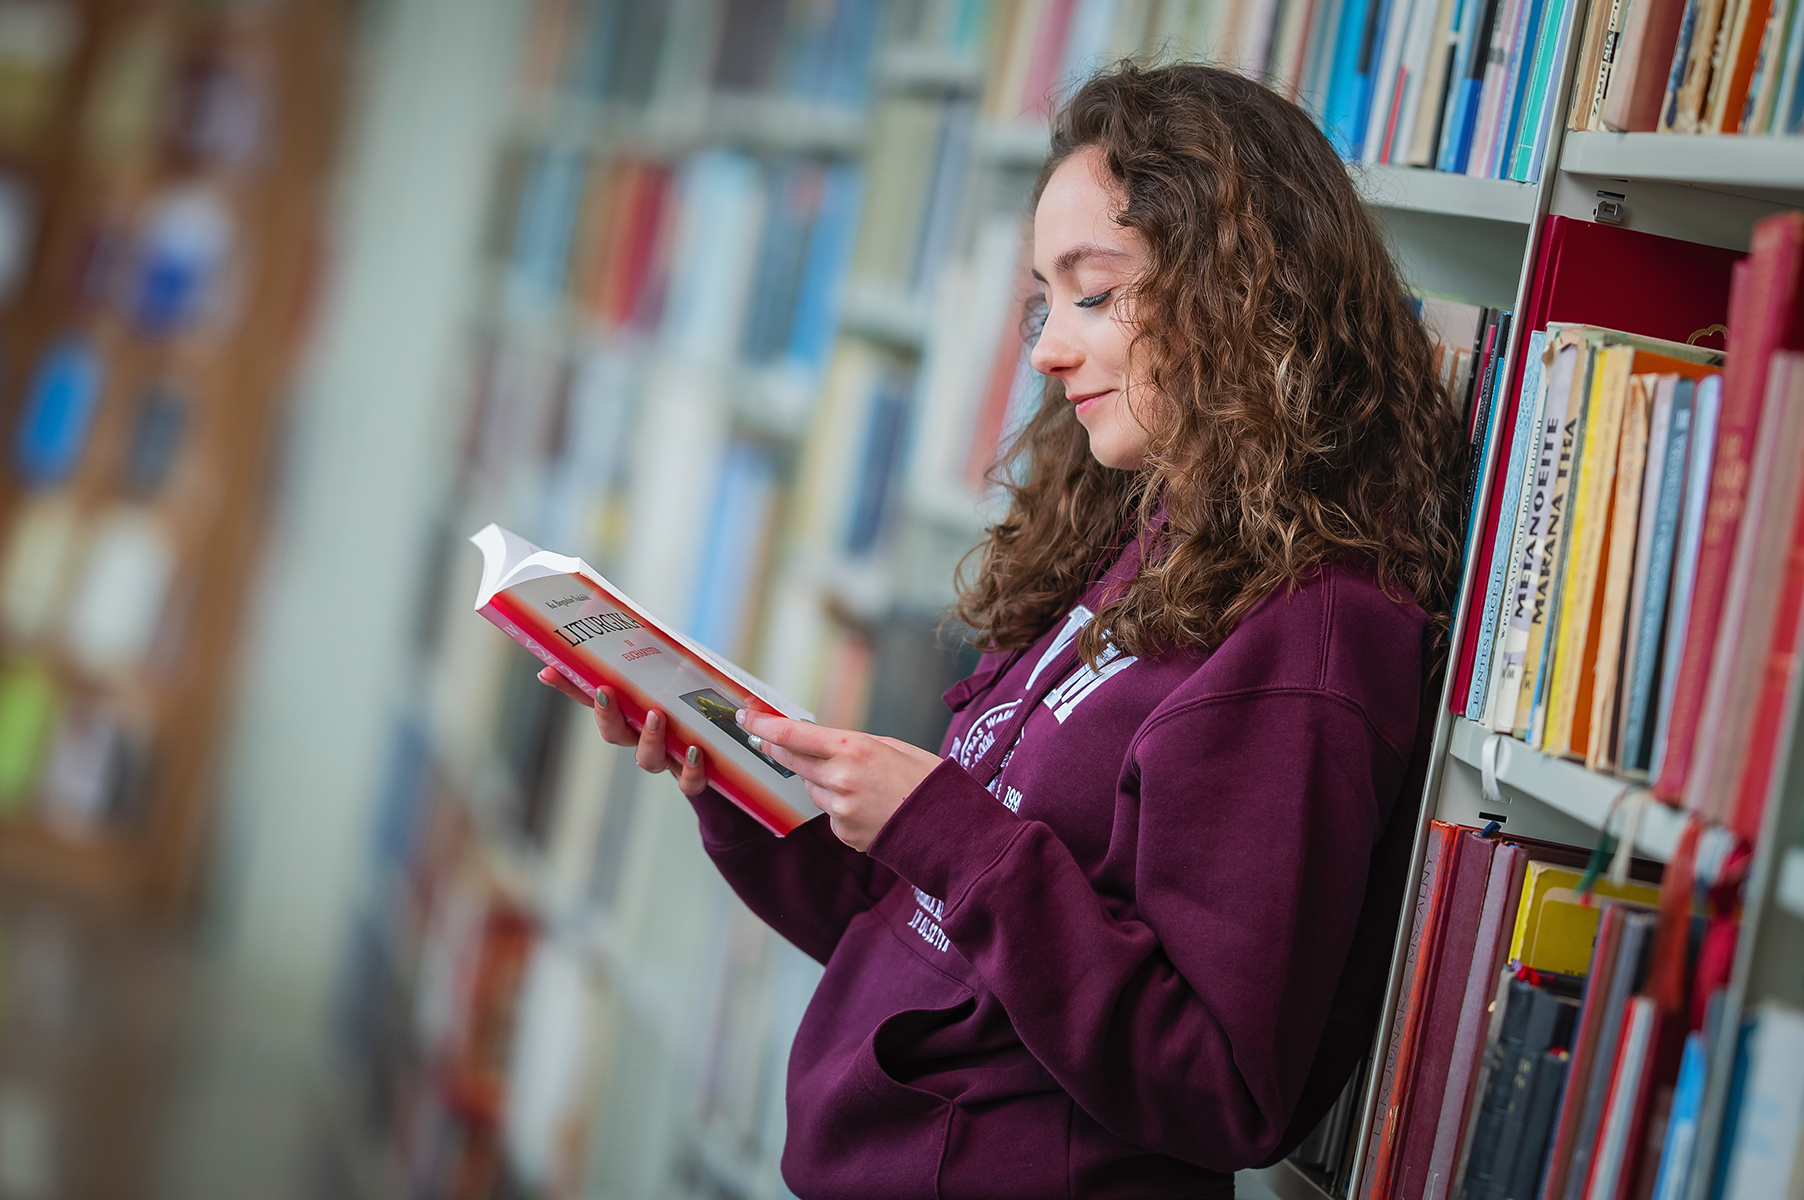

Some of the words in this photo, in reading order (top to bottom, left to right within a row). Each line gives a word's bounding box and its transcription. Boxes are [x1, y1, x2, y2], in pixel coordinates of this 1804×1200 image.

[1501, 521, 1526, 639] WPROWADZENIE
[1522, 494, 1530, 514] DO
[1532, 493, 1564, 624] MARANA
[553, 611, 647, 648] LITURGIKA
[1473, 638, 1490, 706] EUNTES
[1486, 564, 1504, 634] DOCETE
